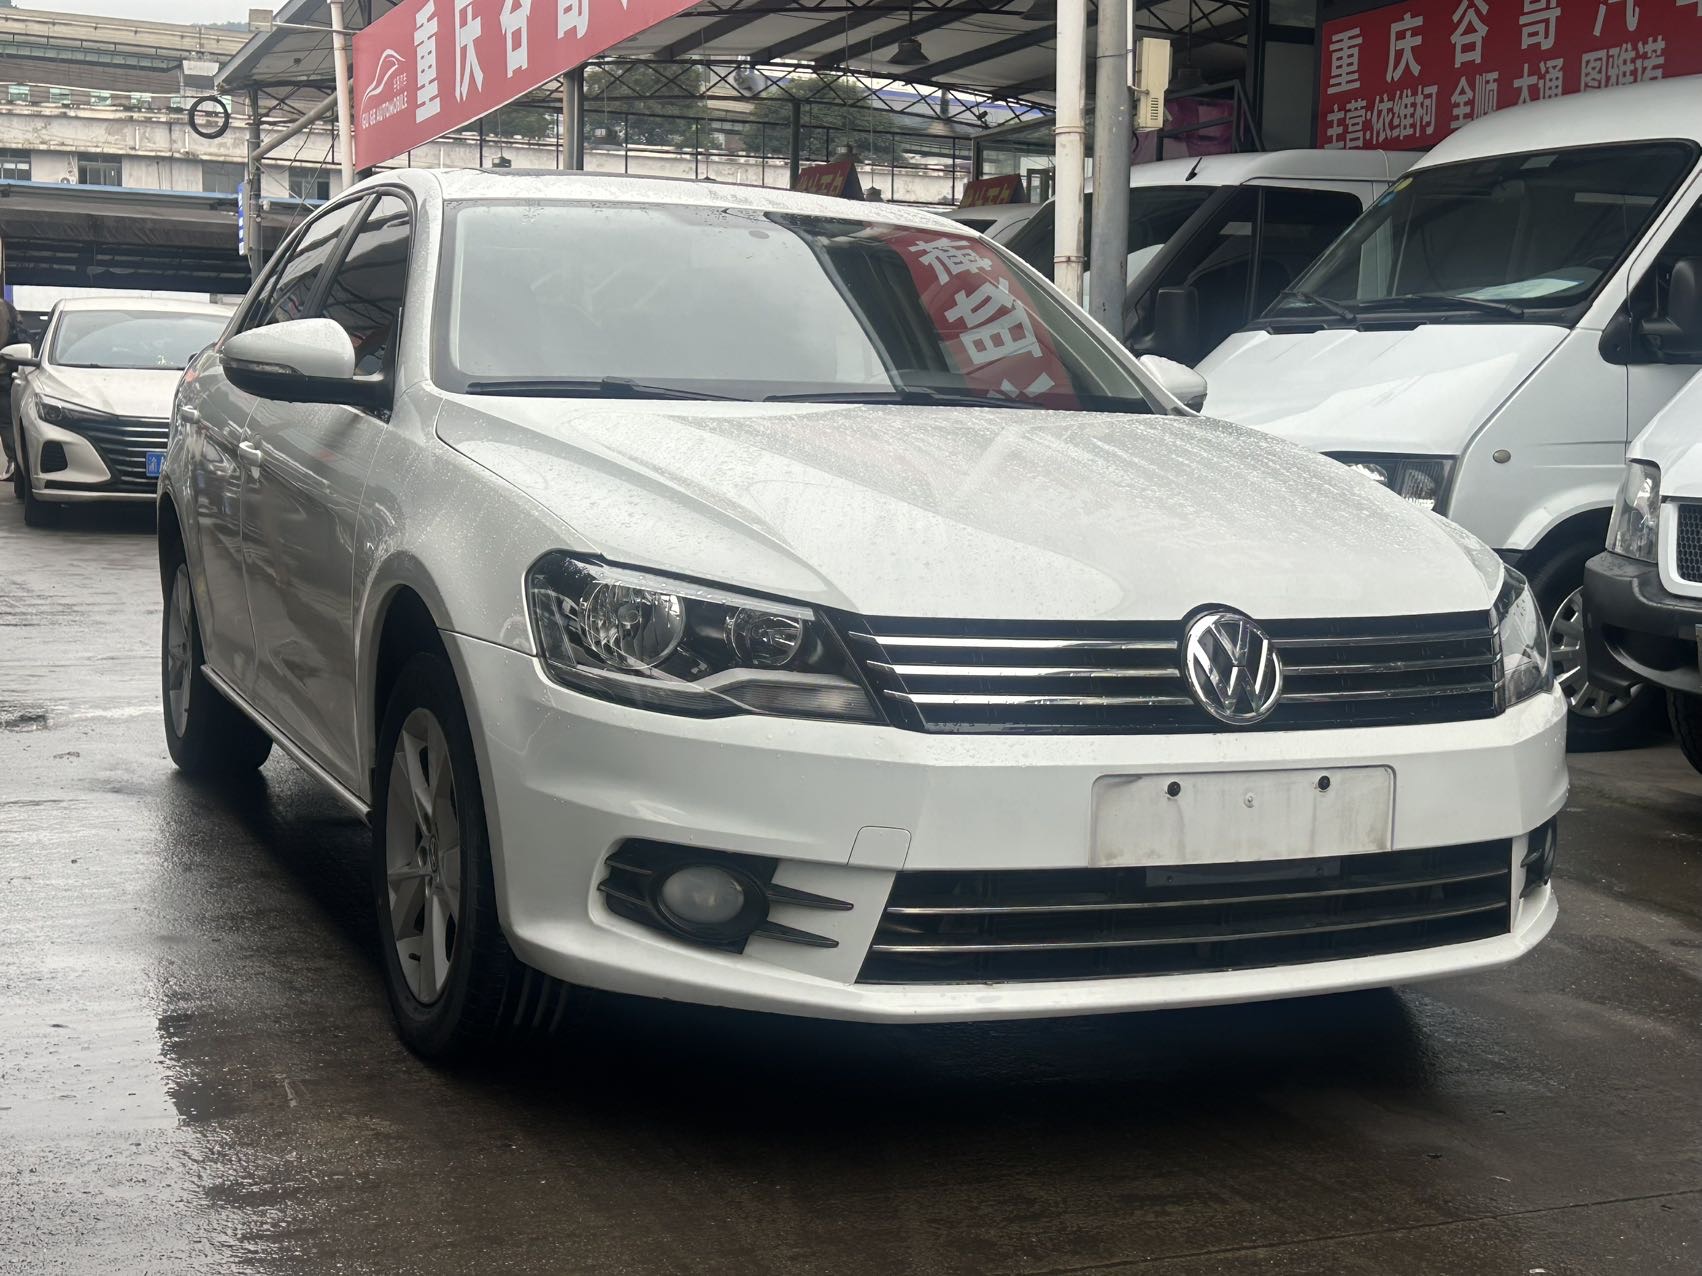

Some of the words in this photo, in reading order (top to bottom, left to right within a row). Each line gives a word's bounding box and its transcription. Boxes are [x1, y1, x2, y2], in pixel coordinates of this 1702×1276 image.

[414, 0, 628, 124] 重庆谷
[1327, 0, 1702, 95] 重庆谷哥
[1450, 71, 1499, 129] 全顺
[1513, 58, 1564, 105] 大通
[1580, 35, 1666, 93] 图雅诺
